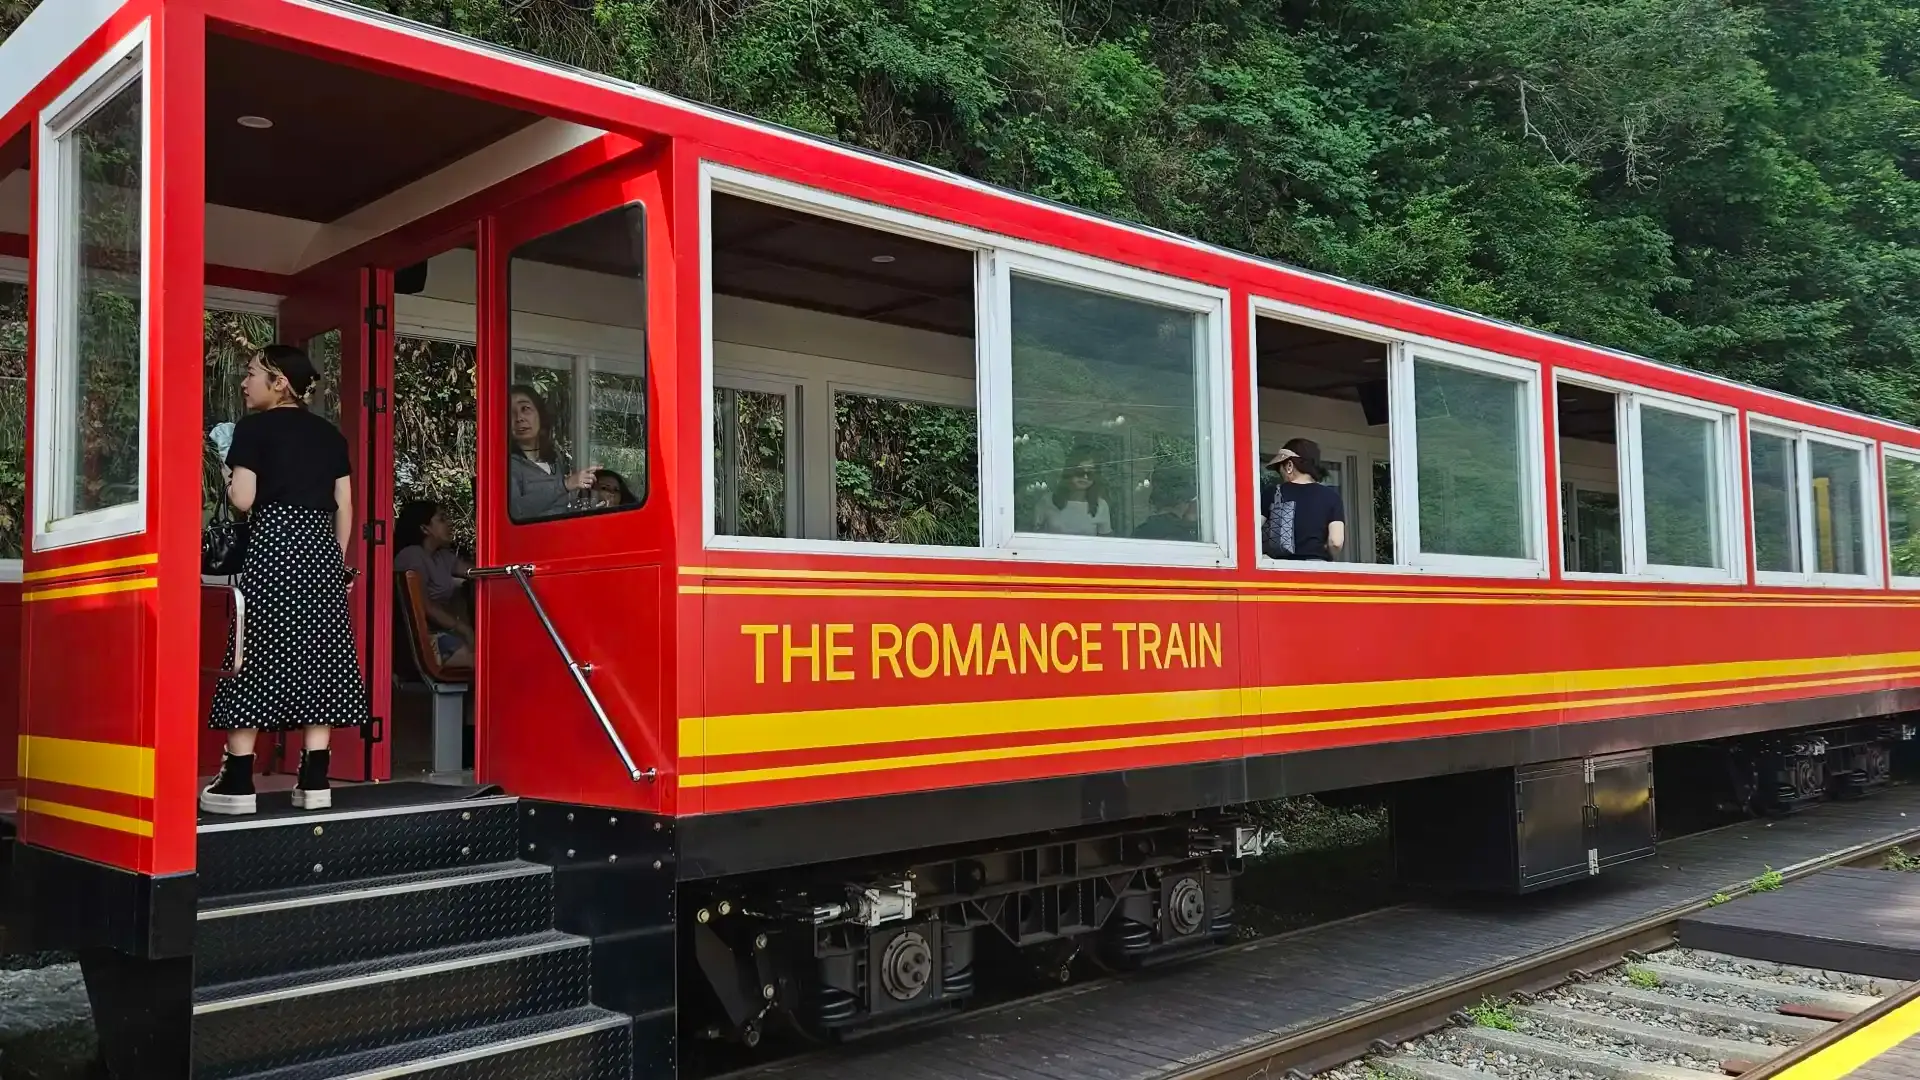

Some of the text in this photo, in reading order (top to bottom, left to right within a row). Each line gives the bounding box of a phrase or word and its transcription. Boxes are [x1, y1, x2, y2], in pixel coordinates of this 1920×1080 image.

[740, 622, 1223, 684] THE ROMANCE TRAIN
